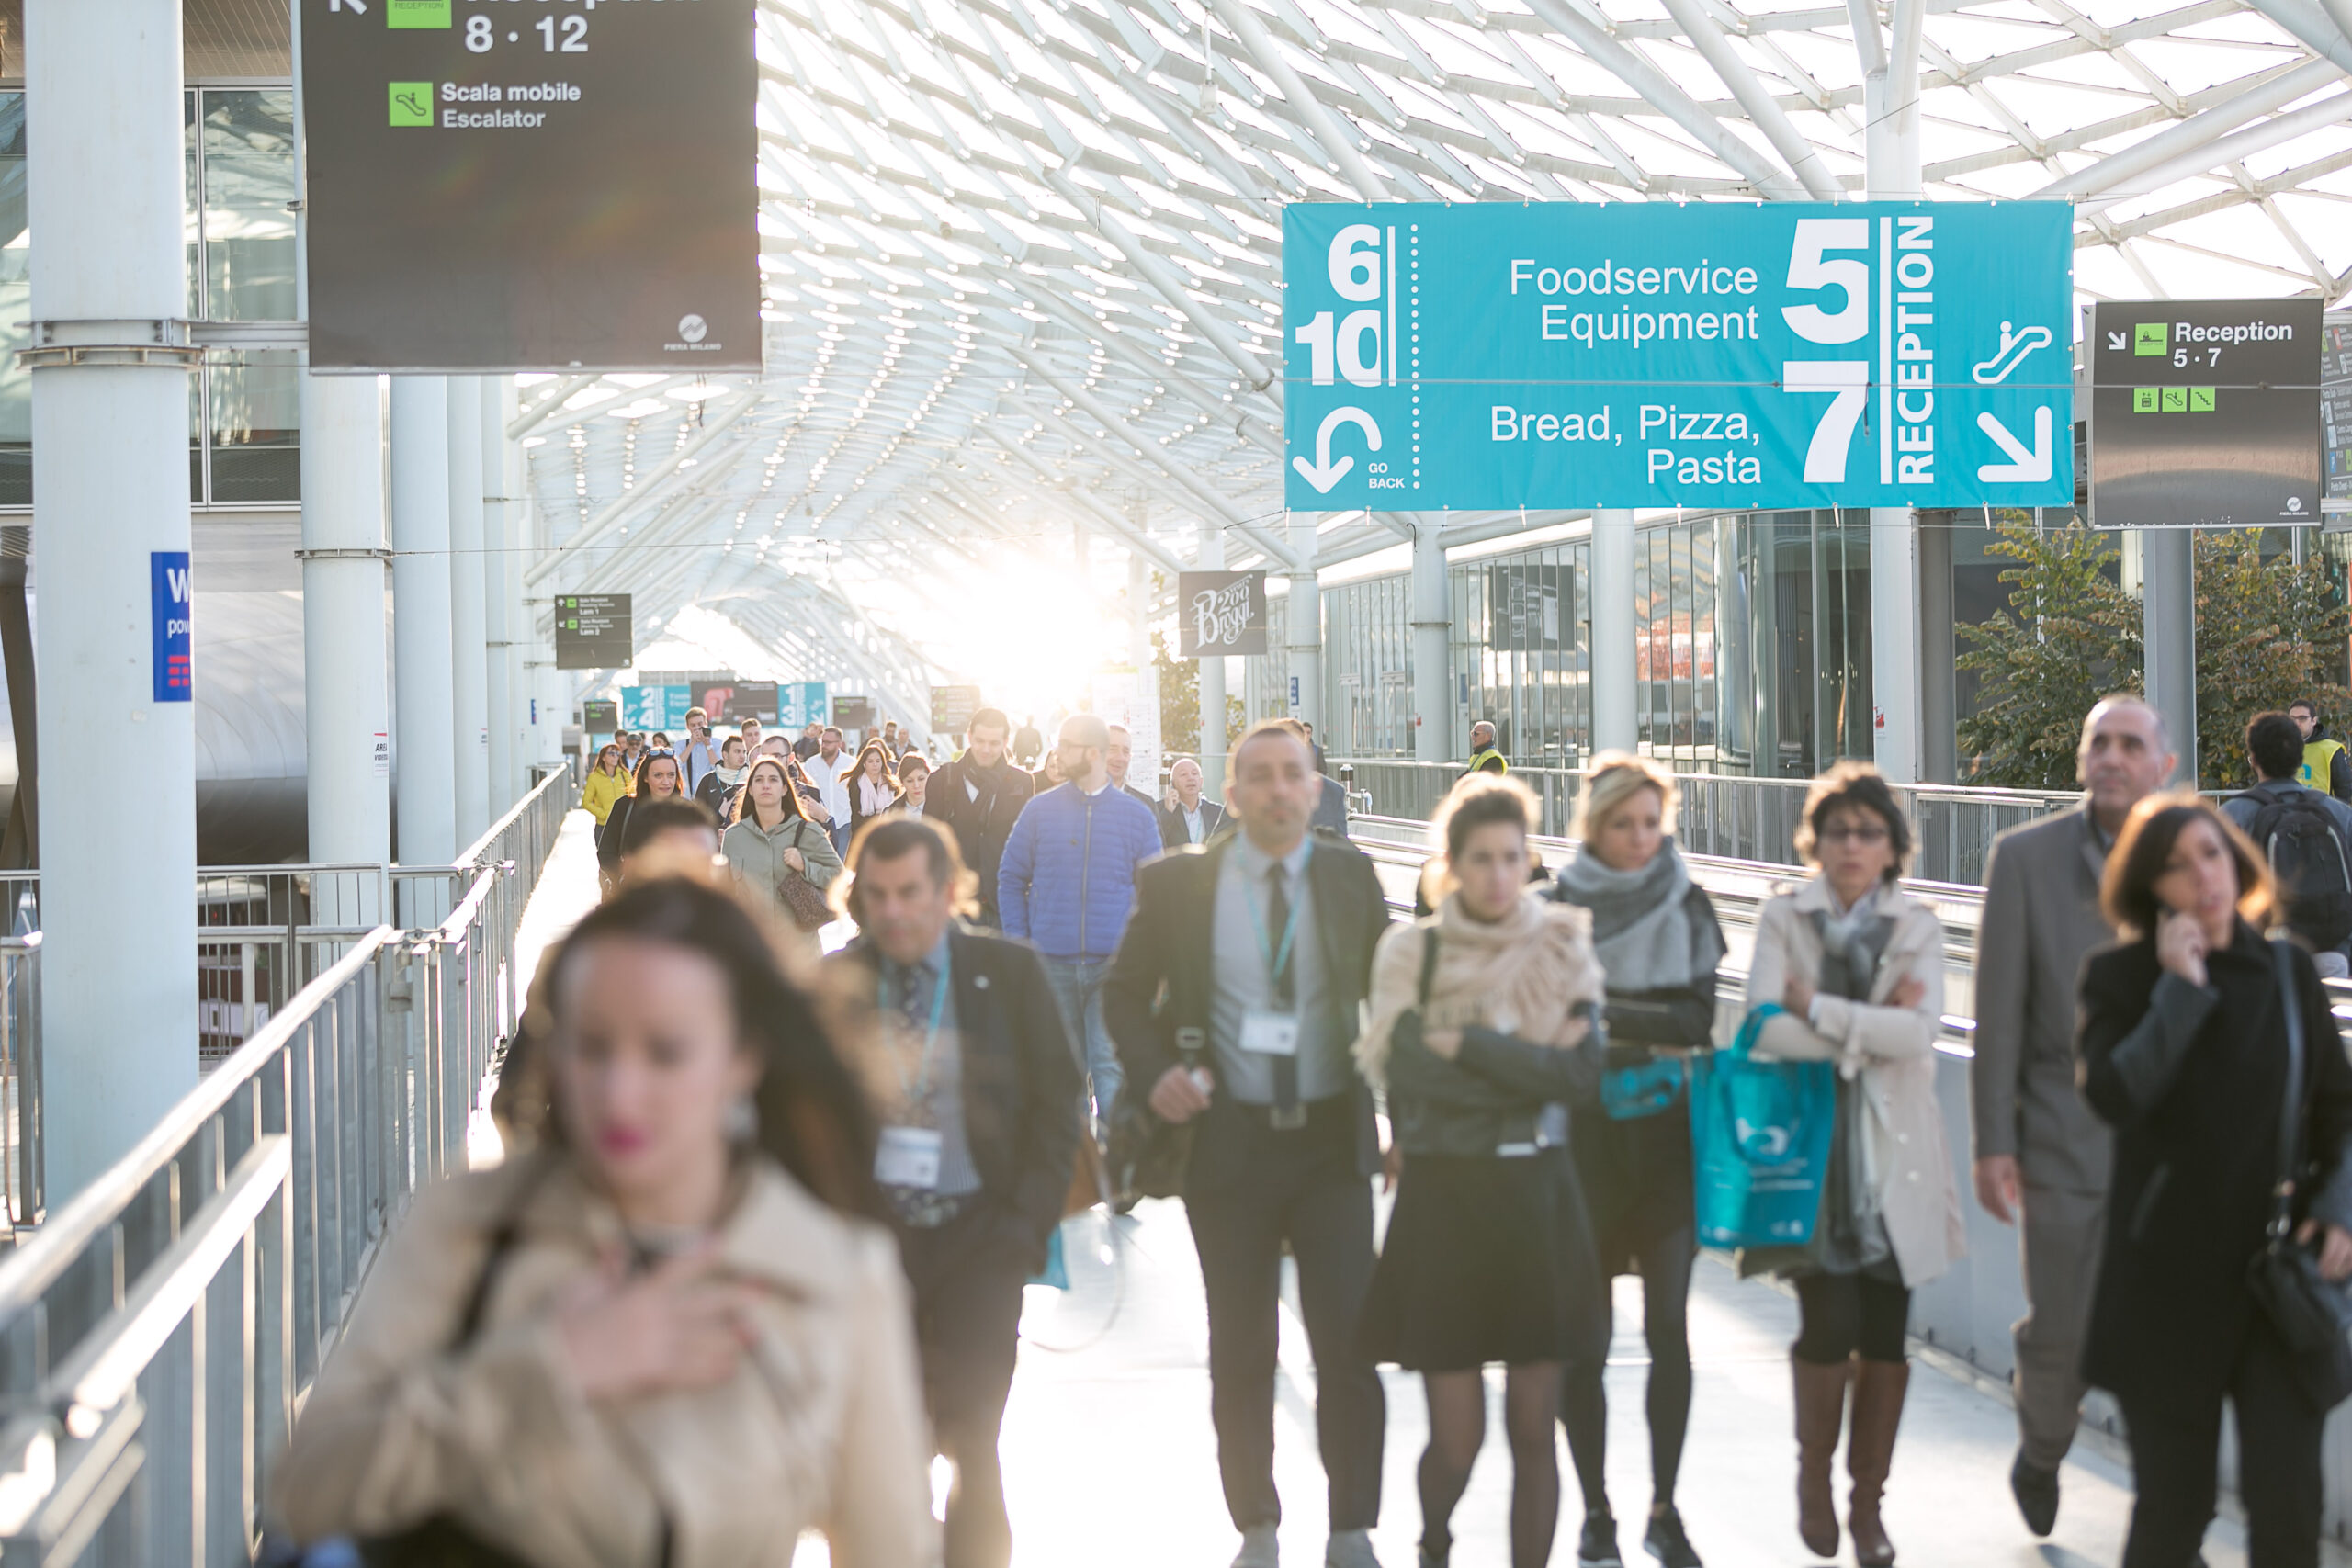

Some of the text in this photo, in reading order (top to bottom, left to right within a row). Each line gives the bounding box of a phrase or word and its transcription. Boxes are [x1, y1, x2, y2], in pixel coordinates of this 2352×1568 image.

[464, 14, 493, 53] 8
[535, 14, 589, 53] 12
[440, 82, 582, 102] Scala mobile
[442, 108, 547, 129] Escalator
[1328, 223, 1381, 302] 6
[1510, 258, 1758, 296] Foodservice
[1781, 218, 1870, 344] 5
[1541, 304, 1759, 349] Equipment
[2175, 321, 2293, 345] Reception
[1295, 309, 1382, 388] 10
[1897, 216, 1934, 484] RECEPTION
[2173, 348, 2188, 368] 5
[2208, 348, 2222, 367] 7
[1491, 404, 1760, 446] Bread, Pizza,
[1782, 361, 1870, 483] 7
[1368, 462, 1388, 474] GO
[1647, 448, 1762, 484] Pasta
[1368, 477, 1406, 489] BACK
[640, 687, 654, 709] 2
[785, 685, 796, 705] 1
[639, 709, 654, 729] 4
[782, 705, 797, 727] 3
[375, 743, 388, 752] ARE
